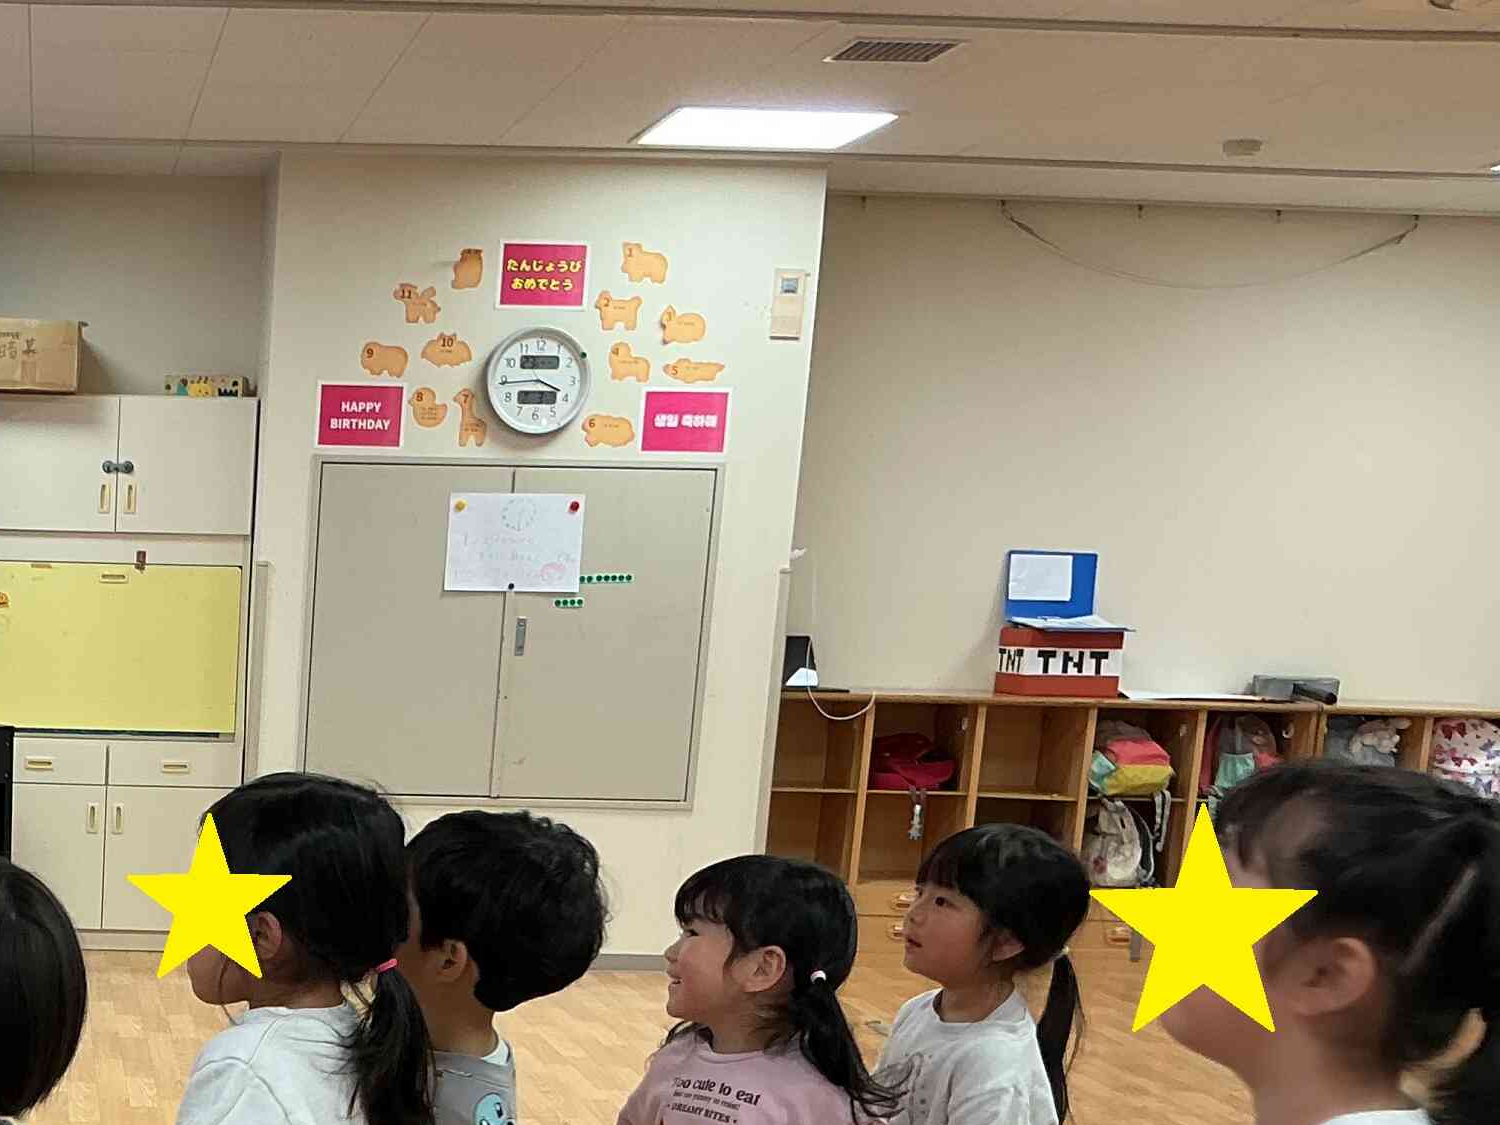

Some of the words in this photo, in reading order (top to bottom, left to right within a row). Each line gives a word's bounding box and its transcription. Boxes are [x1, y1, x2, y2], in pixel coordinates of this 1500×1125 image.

[506, 258, 582, 273] たんじょうび
[511, 277, 573, 291] おめでとう
[400, 289, 412, 300] 11
[441, 337, 454, 348] 10
[536, 340, 547, 352] 12
[366, 347, 374, 358] 9
[520, 343, 529, 354] 11
[505, 357, 517, 369] 10
[565, 357, 573, 368] 2
[671, 365, 678, 376] 5
[569, 376, 576, 386] 3
[415, 391, 424, 402] 8
[461, 394, 470, 404] 7
[504, 391, 512, 402] 8
[562, 393, 569, 402] 4
[340, 401, 382, 413] HAPPY
[516, 405, 523, 417] 7
[550, 405, 557, 417] 5
[532, 411, 540, 421] 6
[330, 418, 391, 431] BIRTHDAY
[588, 418, 596, 428] 6
[999, 648, 1025, 673] TNT
[1037, 650, 1109, 676] TNT
[693, 1079, 717, 1092] cute
[719, 1082, 732, 1096] to
[736, 1090, 760, 1106] eat
